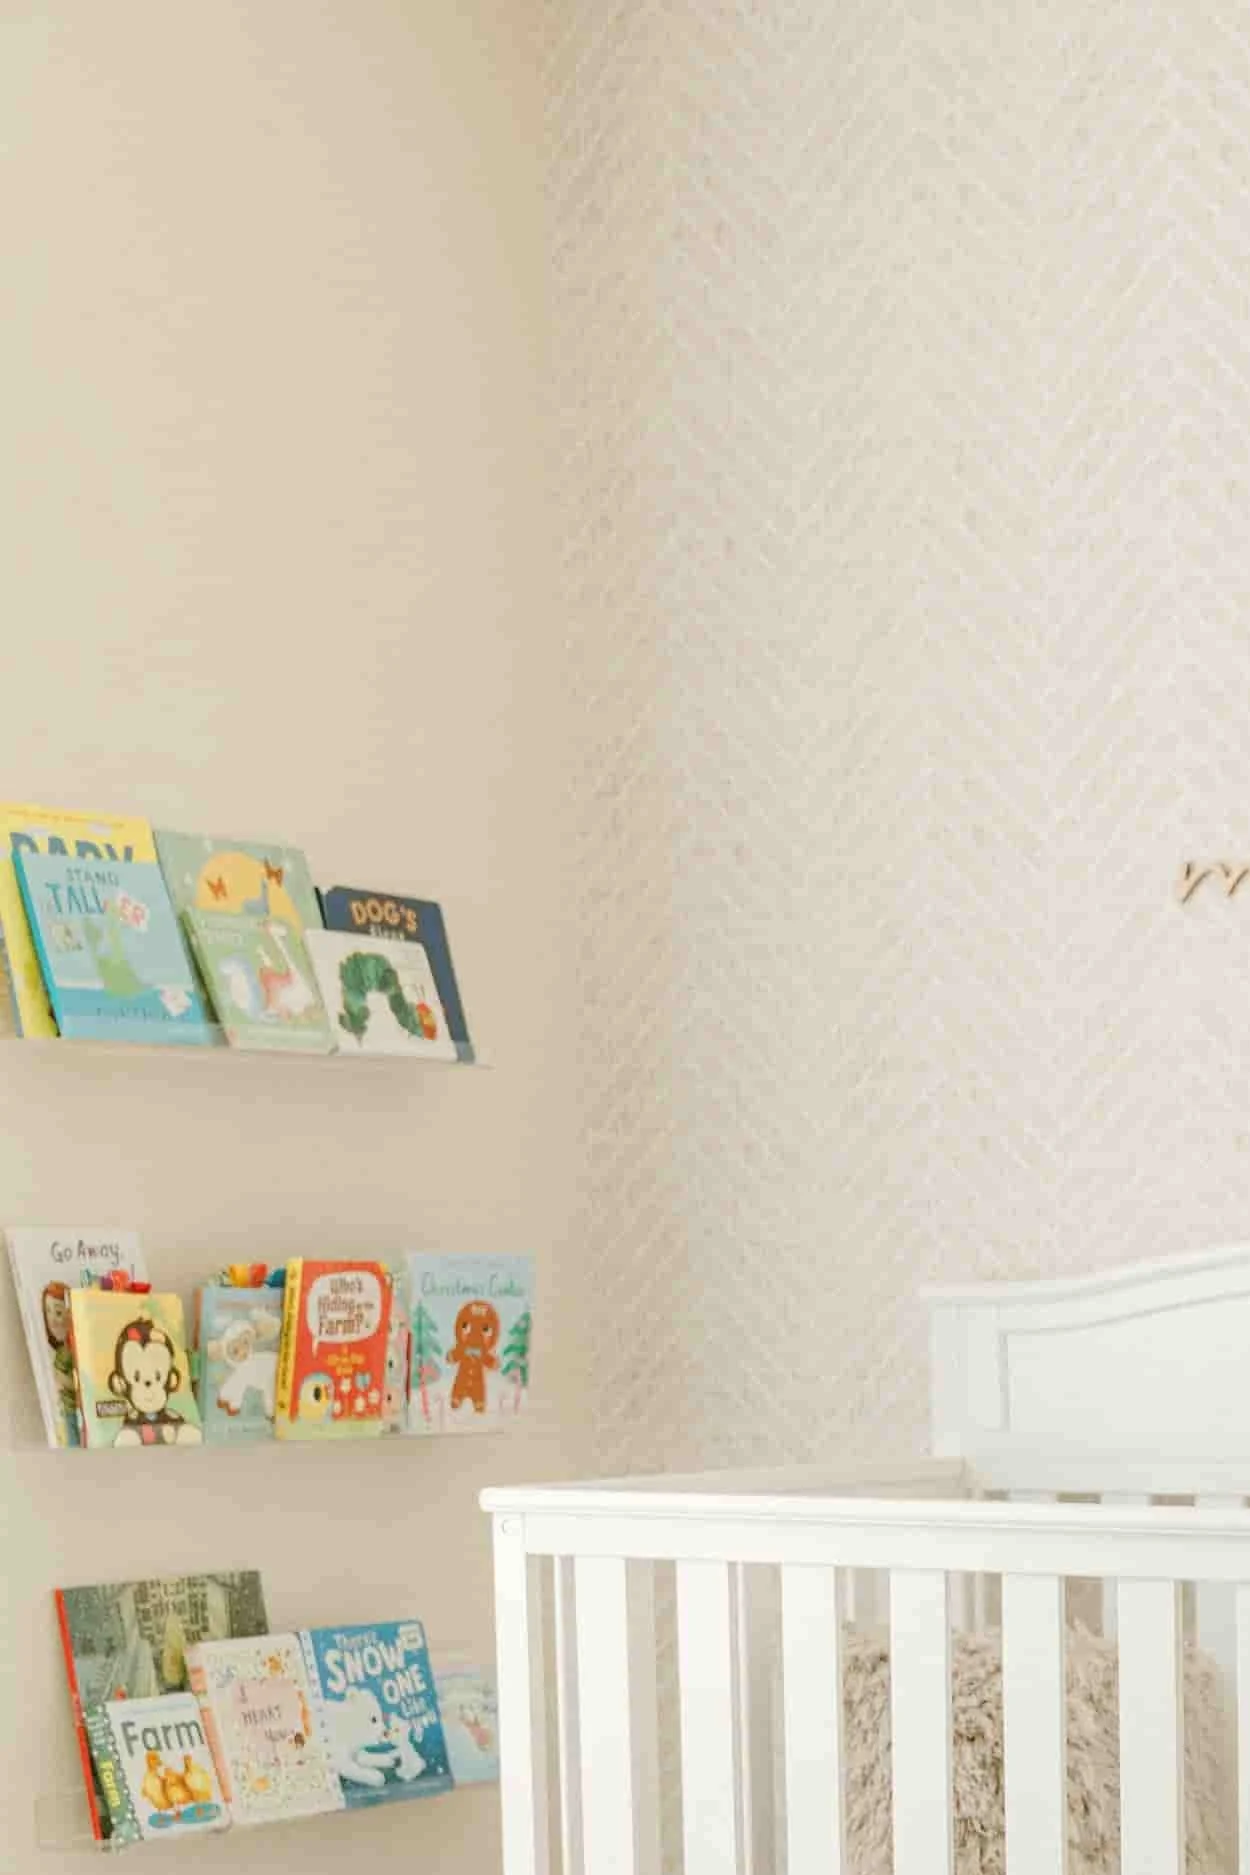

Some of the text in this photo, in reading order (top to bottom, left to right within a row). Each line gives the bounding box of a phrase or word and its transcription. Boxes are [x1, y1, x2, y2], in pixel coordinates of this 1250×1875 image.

[50, 1241, 73, 1264] Go
[325, 1638, 407, 1694] SNOW
[383, 1664, 427, 1704] ONE
[119, 1720, 206, 1756] Farm
